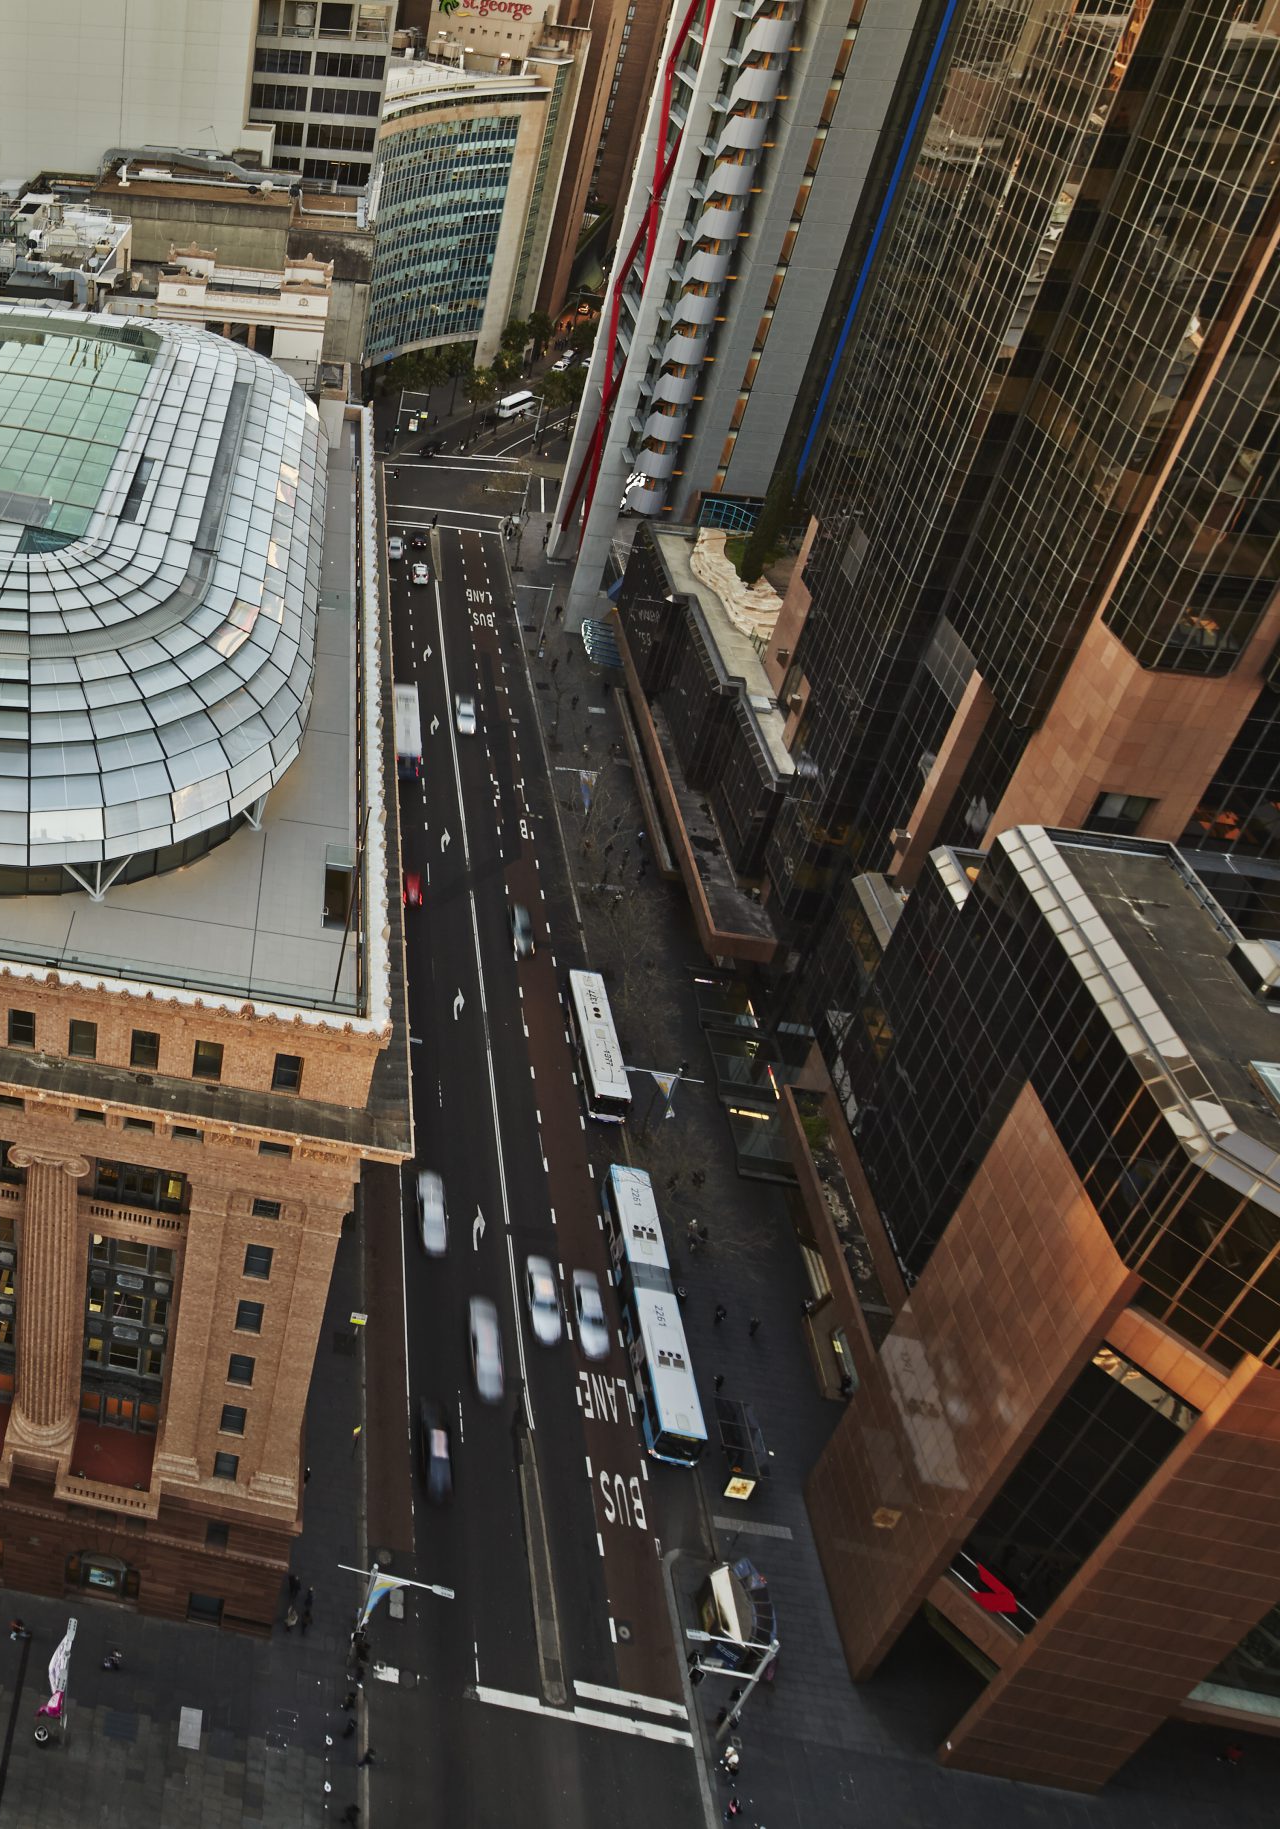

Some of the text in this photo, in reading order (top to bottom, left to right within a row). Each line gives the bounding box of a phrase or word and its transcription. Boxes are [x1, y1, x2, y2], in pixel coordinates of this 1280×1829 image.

[473, 612, 494, 627] BUS
[654, 1305, 667, 1327] 2261
[579, 1371, 634, 1427] LANE
[599, 1470, 648, 1530] BUS
